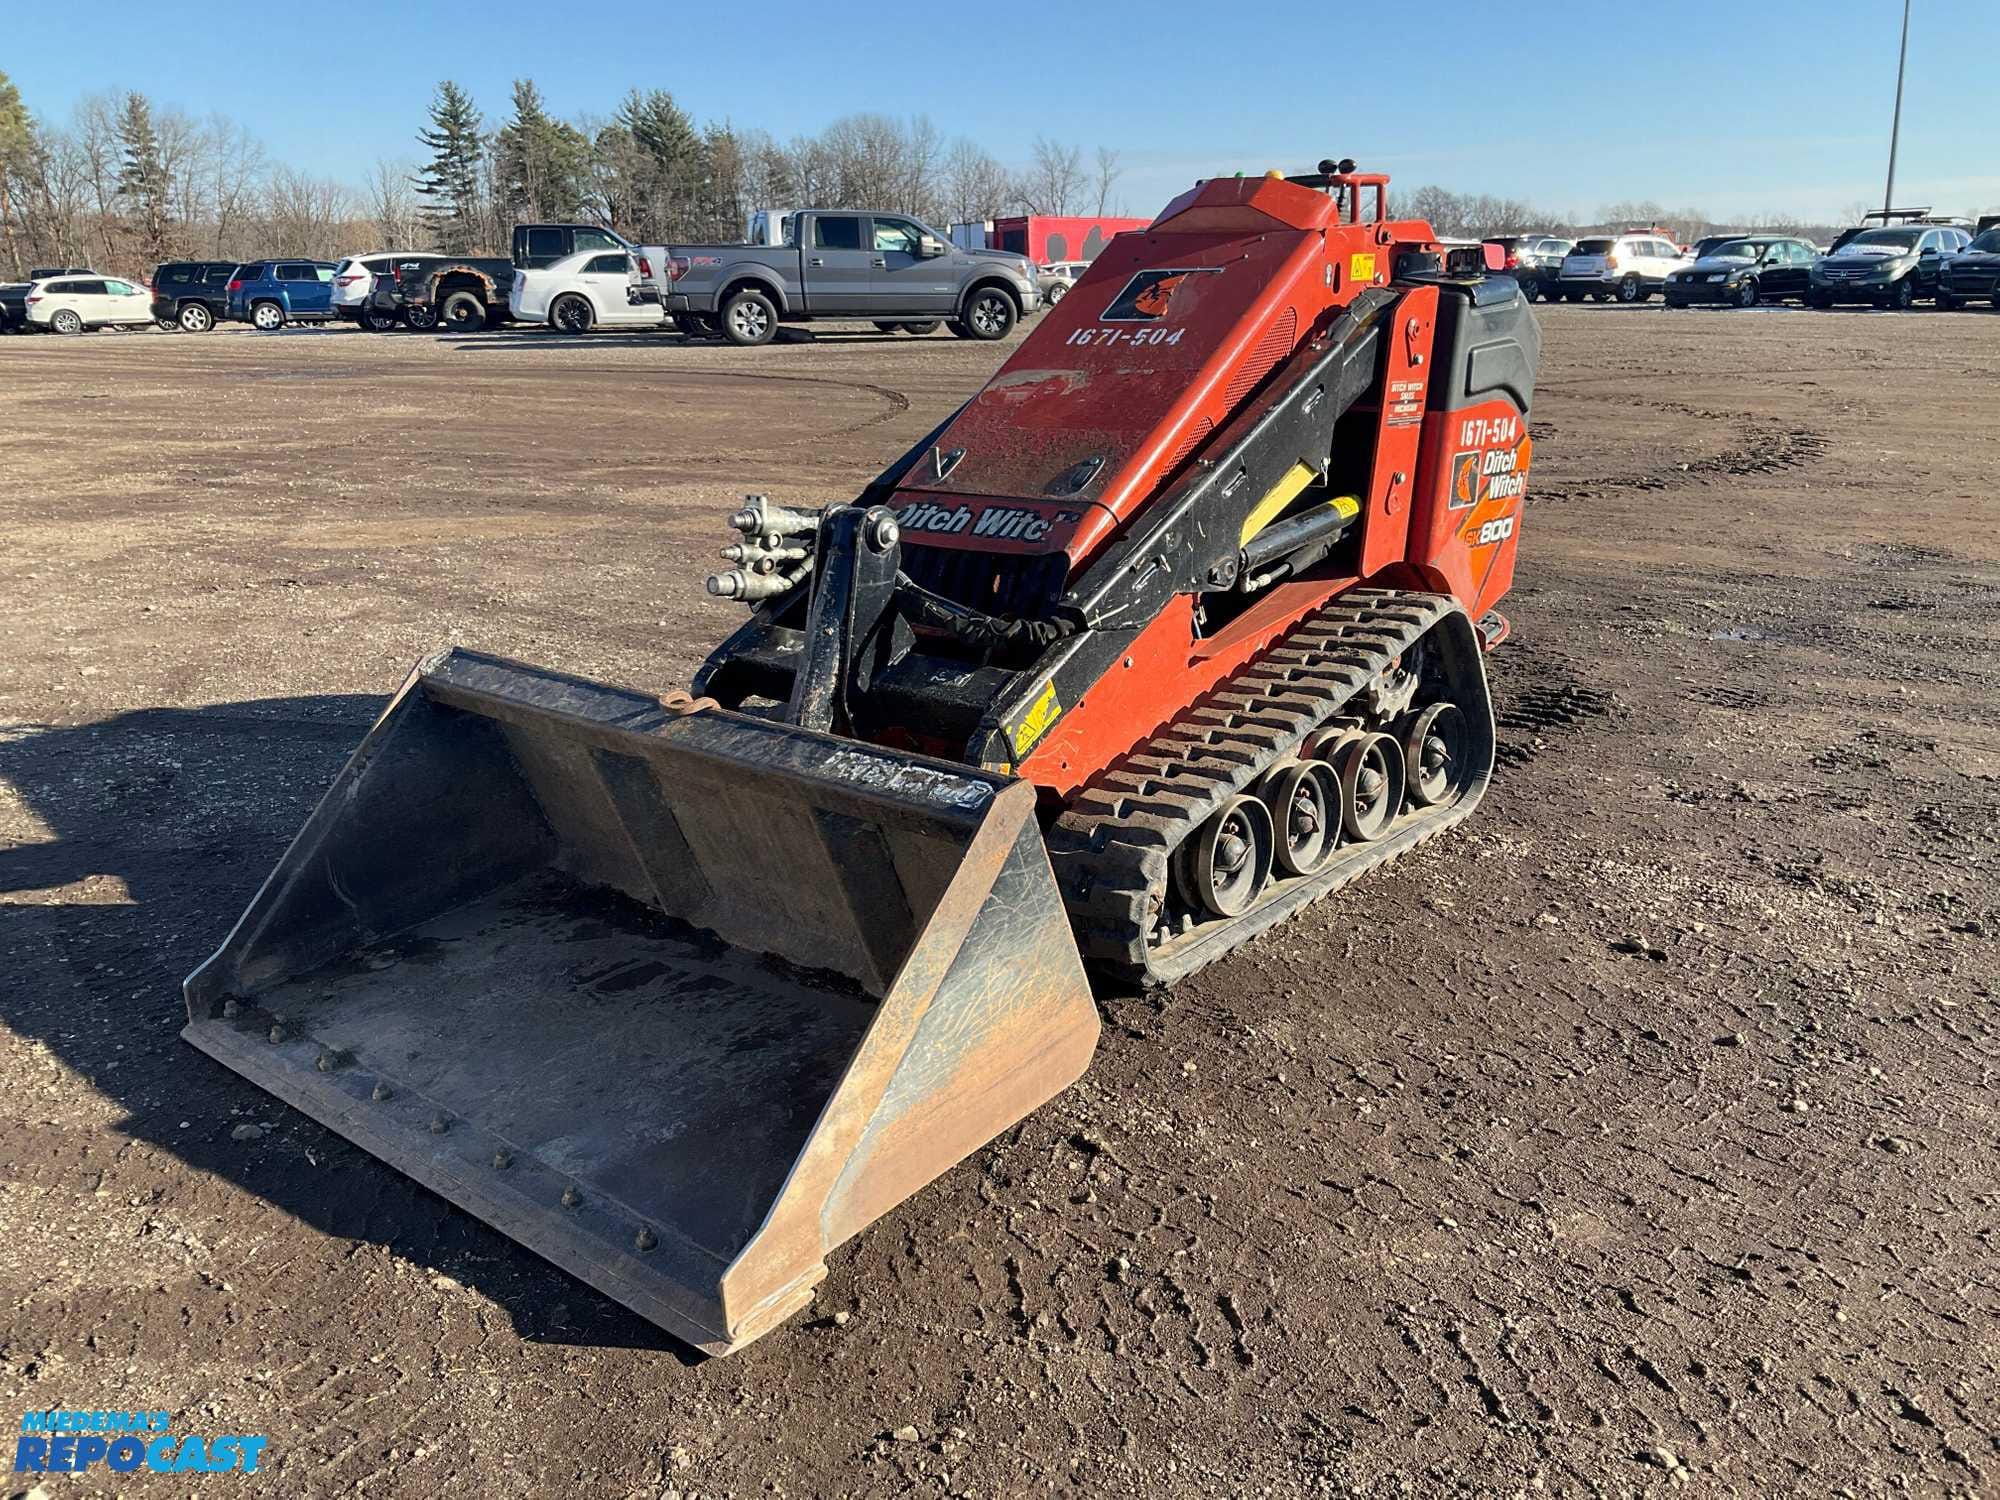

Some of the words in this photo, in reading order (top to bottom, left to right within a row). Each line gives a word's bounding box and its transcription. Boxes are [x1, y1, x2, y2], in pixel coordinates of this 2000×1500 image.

[1066, 328, 1186, 346] 1671-504
[1460, 416, 1517, 447] 1671-504
[1483, 448, 1516, 475] Ditch
[1489, 471, 1523, 499] Witch
[973, 508, 1053, 540] Witc
